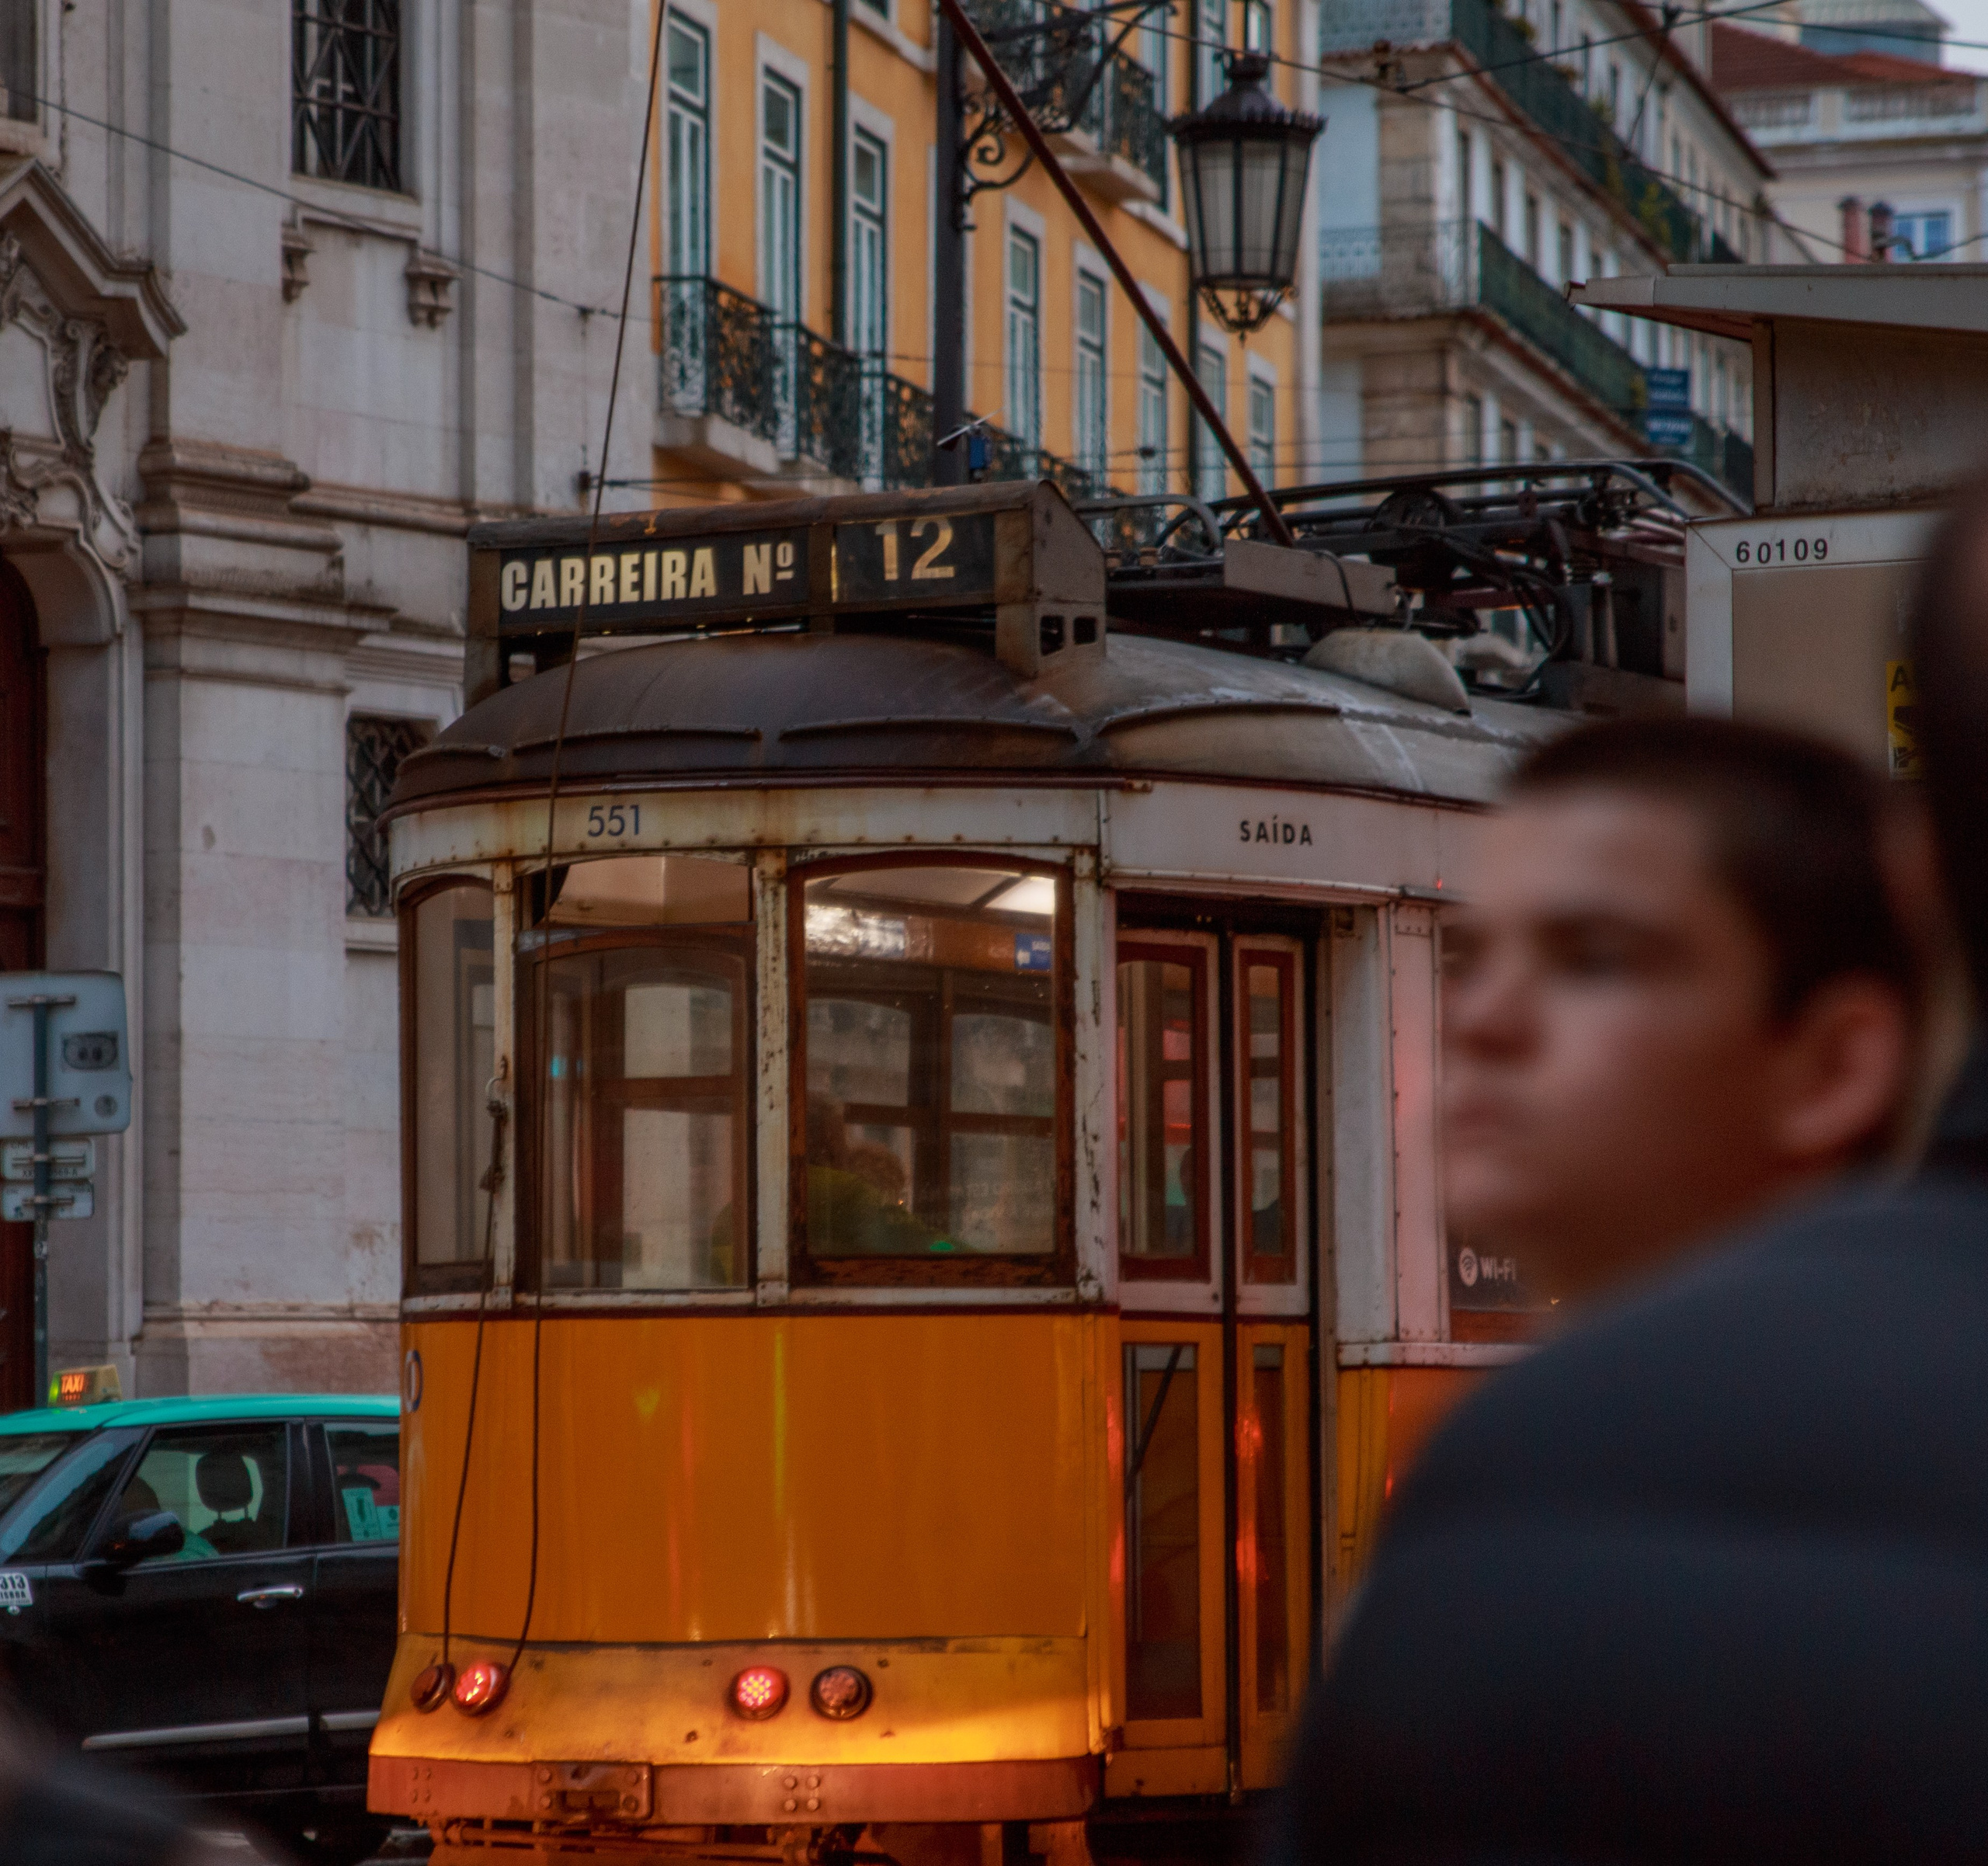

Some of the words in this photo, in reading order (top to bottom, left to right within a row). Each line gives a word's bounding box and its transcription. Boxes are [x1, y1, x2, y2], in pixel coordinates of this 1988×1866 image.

[501, 547, 718, 612] CARREIRA
[874, 516, 955, 581] 12
[1736, 537, 1828, 564] 60109
[587, 804, 640, 837] 551
[1240, 814, 1312, 846] SAÍDA
[61, 1374, 85, 1394] TAXI
